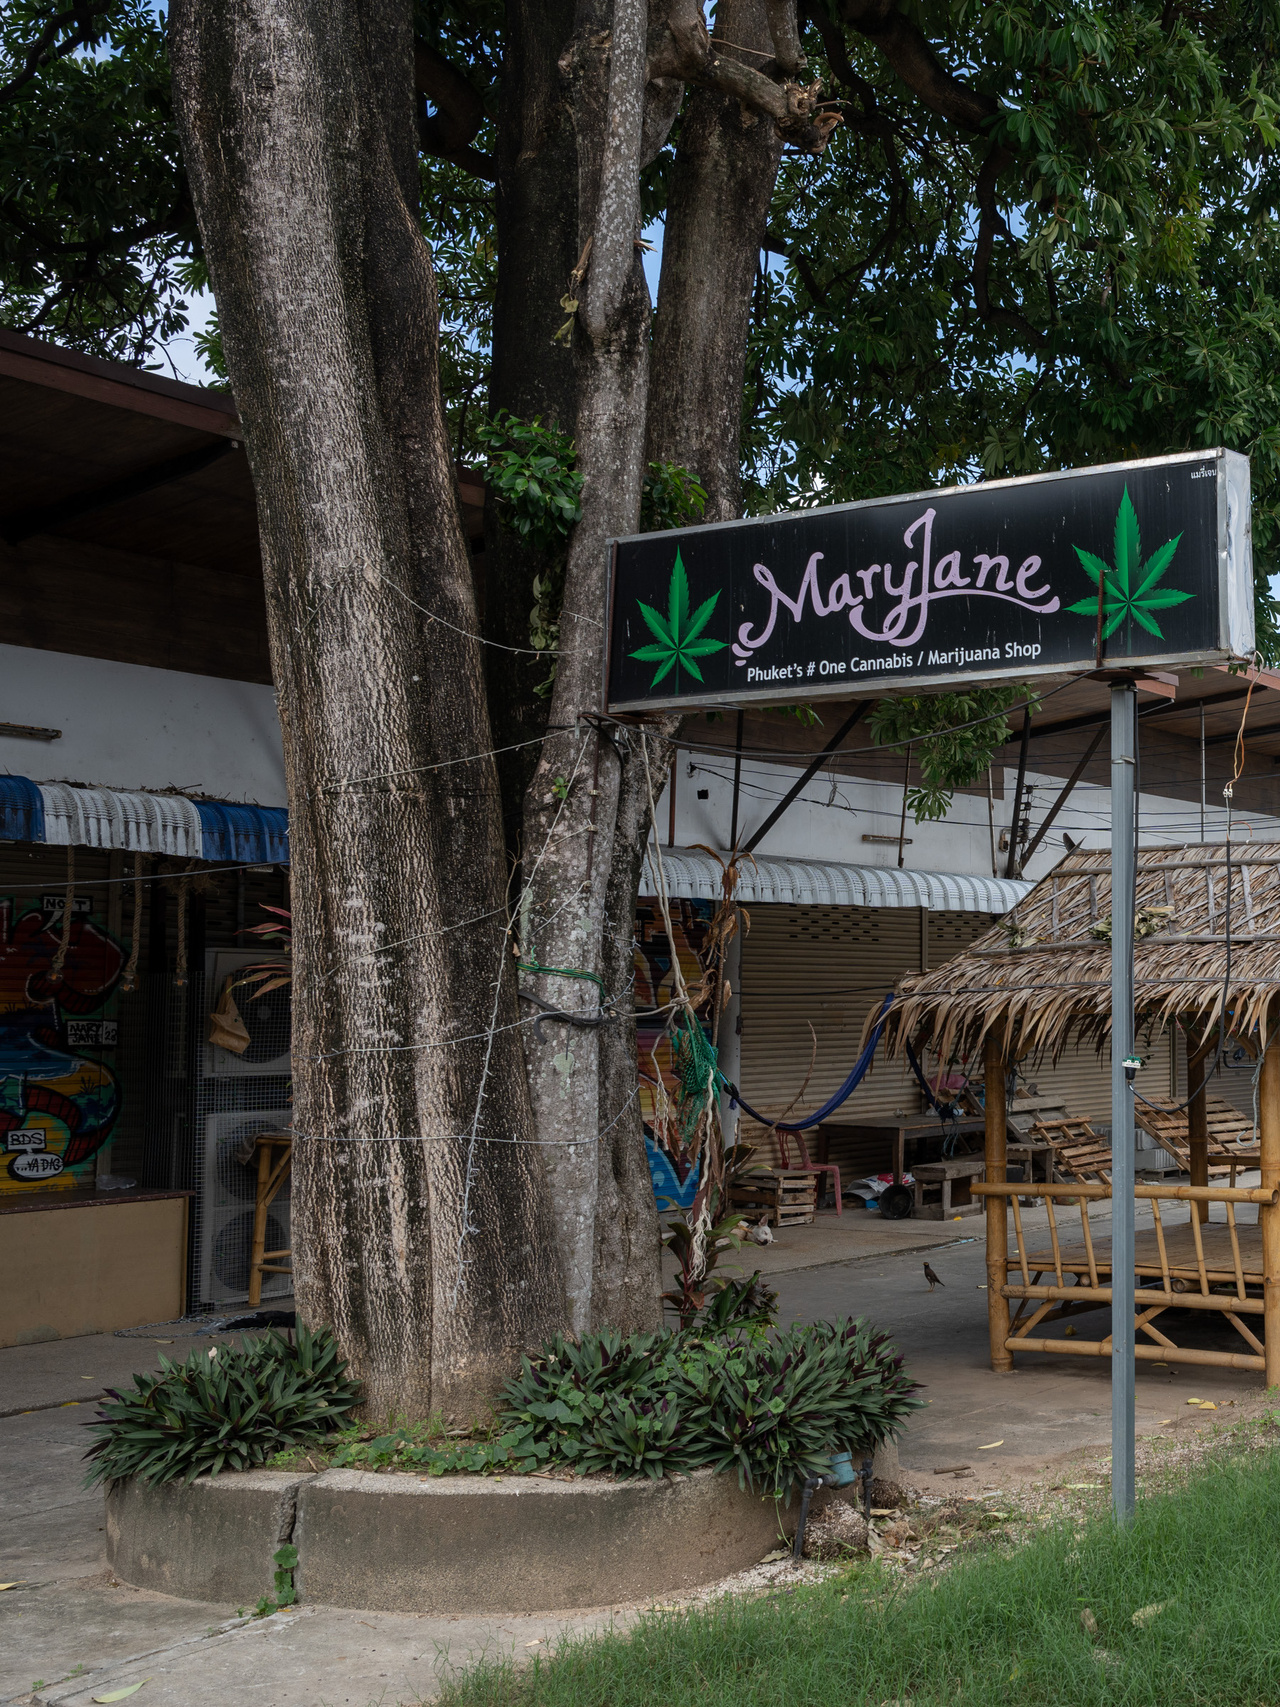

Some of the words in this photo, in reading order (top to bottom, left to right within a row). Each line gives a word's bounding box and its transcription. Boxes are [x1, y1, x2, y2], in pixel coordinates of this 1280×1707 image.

[747, 663, 803, 682] Phuket's
[819, 660, 847, 675] One
[850, 653, 914, 672] Cannabis
[927, 647, 1000, 666] Marijuana
[1005, 641, 1041, 659] Shop
